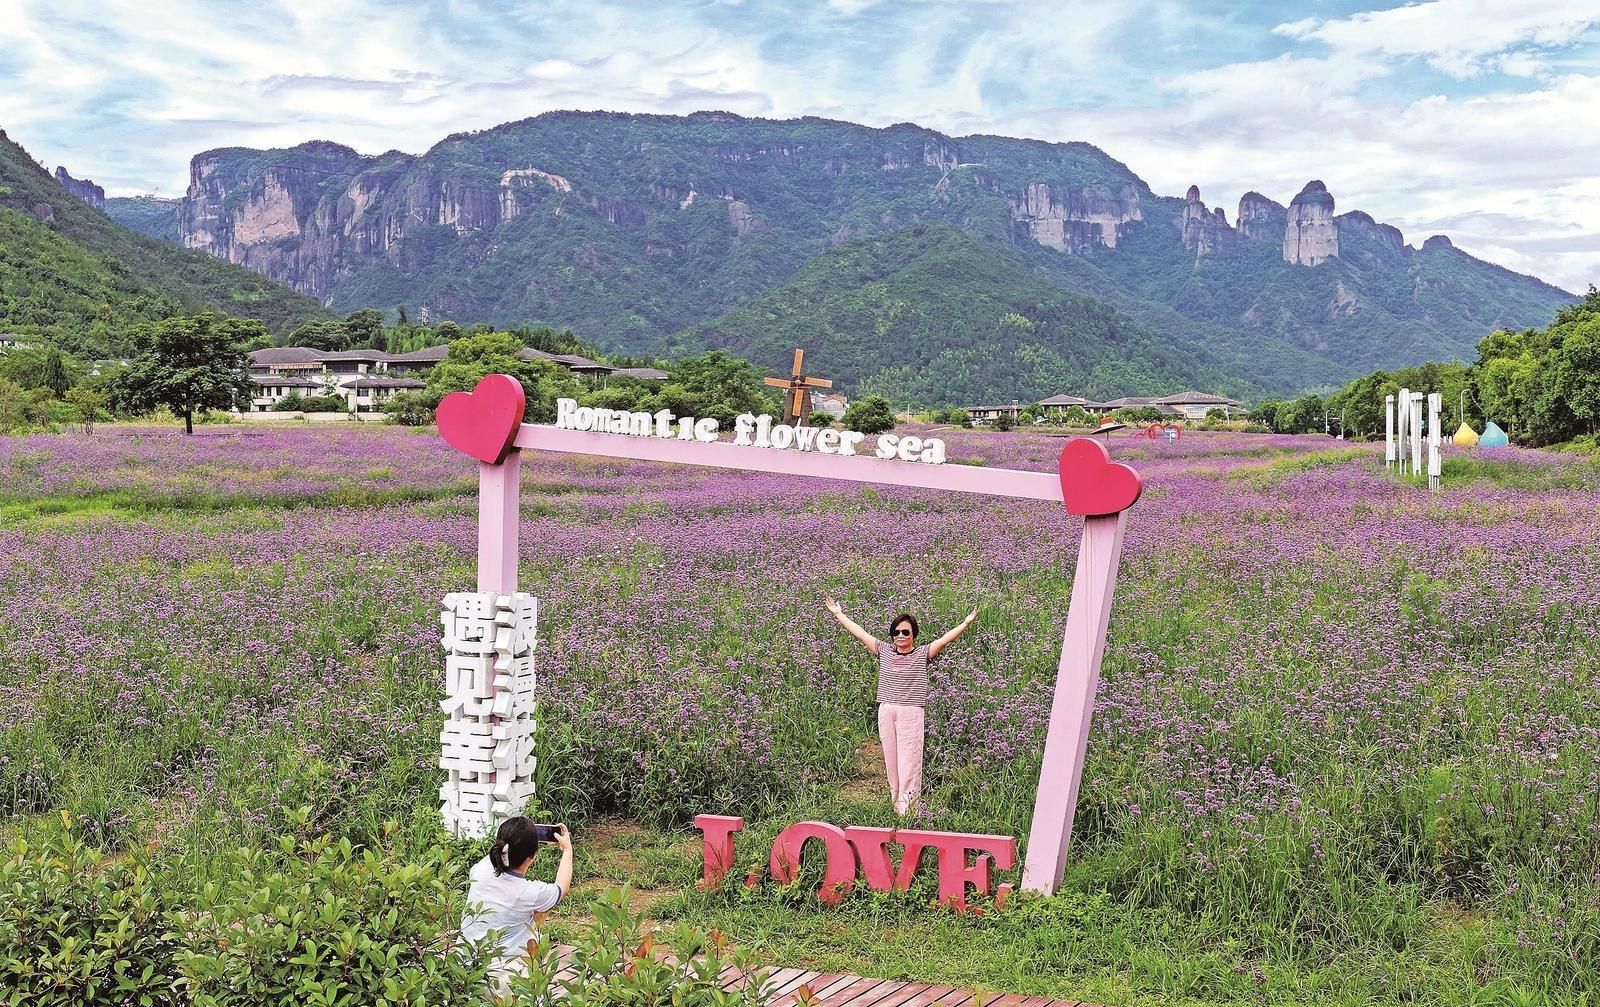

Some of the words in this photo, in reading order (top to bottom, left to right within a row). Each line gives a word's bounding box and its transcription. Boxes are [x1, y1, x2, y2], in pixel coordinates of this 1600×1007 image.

[556, 397, 720, 443] Romantic
[734, 412, 866, 457] flower
[876, 433, 947, 465] sea
[439, 592, 496, 838] 遇见幸福
[694, 813, 1015, 914] LOVE
